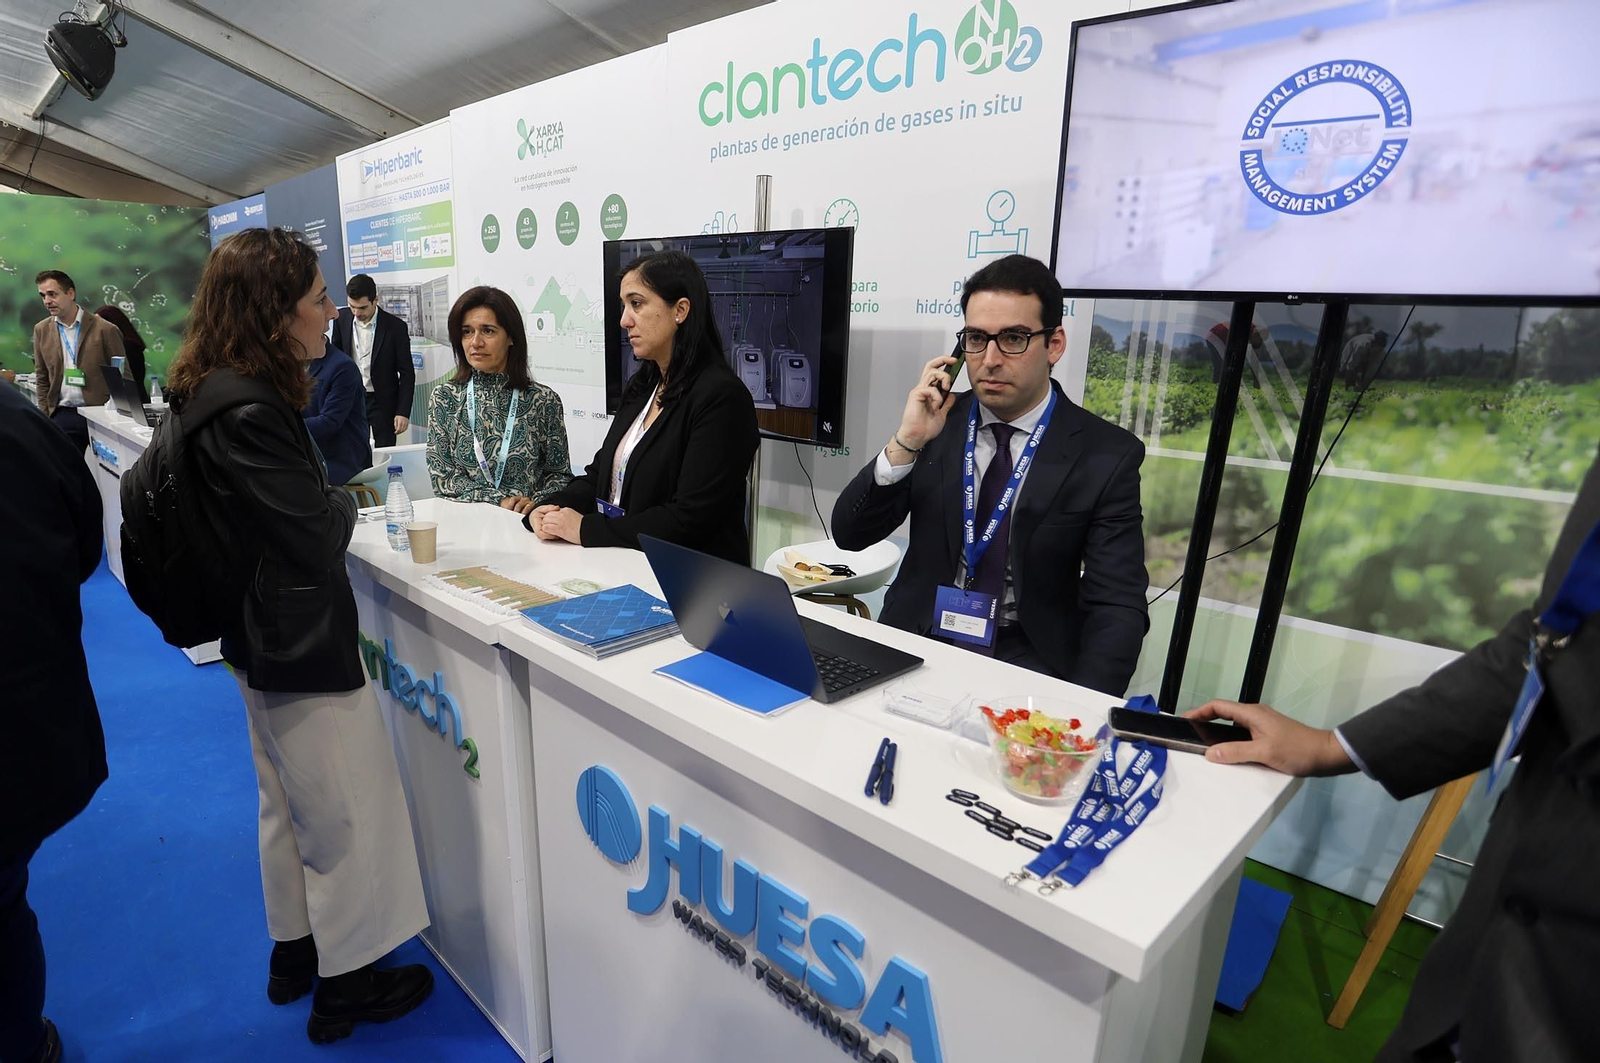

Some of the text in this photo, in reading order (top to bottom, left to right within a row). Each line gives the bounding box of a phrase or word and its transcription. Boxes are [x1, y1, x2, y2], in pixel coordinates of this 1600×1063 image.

[698, 12, 947, 127] clantech
[1246, 63, 1409, 138] SOCIAL RESPONSIBILITY
[536, 121, 564, 139] XARXA
[710, 93, 1023, 163] plantas de generación de gases in situ
[373, 146, 423, 180] Hiperbaric
[1243, 143, 1403, 213] MANAGEMENT SYSTEM
[564, 211, 569, 220] 7
[607, 203, 620, 214] +80
[484, 224, 497, 235] +250
[522, 217, 530, 226] 43
[916, 298, 962, 318] hidróg
[989, 597, 998, 619] GENERAL
[672, 898, 747, 967] WATER
